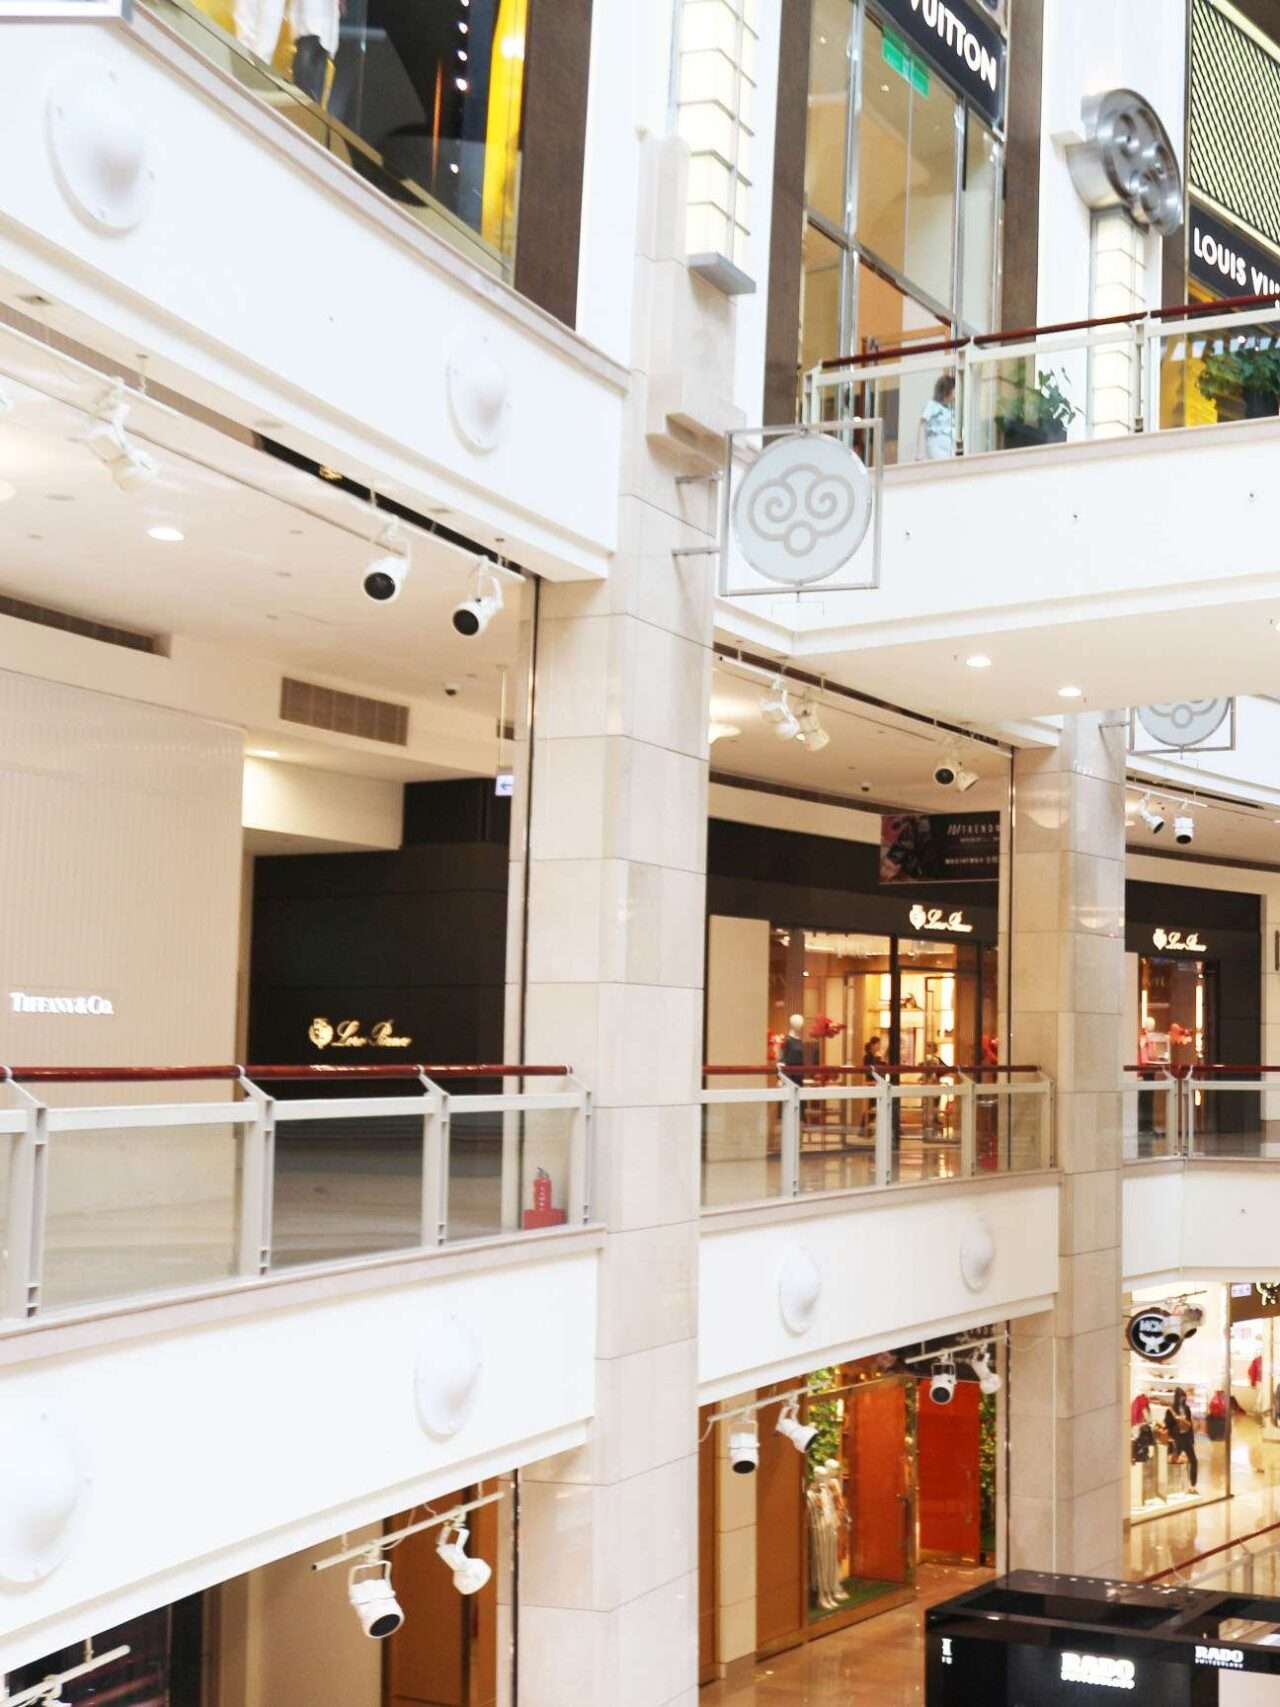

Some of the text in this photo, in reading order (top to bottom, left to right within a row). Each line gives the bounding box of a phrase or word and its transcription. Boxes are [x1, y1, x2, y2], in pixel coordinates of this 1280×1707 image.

[1193, 227, 1247, 286] LOUIS
[1061, 1652, 1136, 1680] RADO
[1195, 1645, 1244, 1663] RADO
